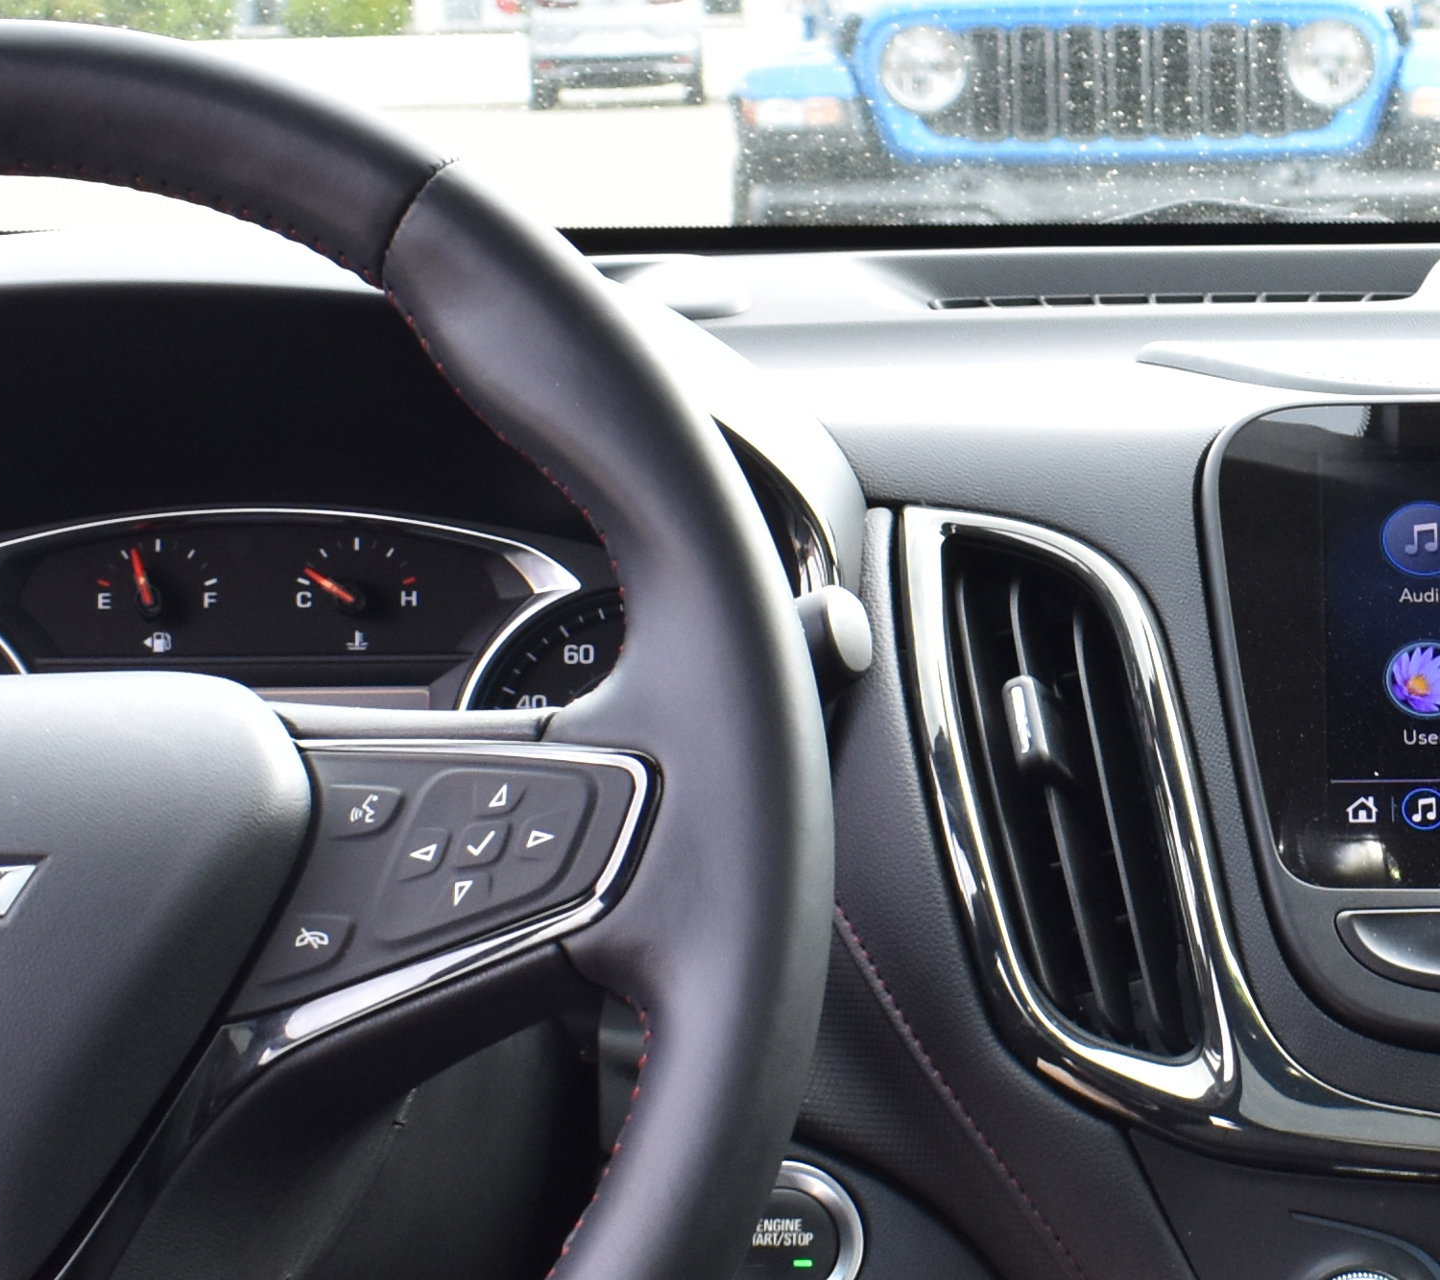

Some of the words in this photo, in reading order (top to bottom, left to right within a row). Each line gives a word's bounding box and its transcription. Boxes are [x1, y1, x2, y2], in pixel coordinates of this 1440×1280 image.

[96, 592, 112, 610] E
[202, 591, 218, 609] F
[296, 591, 313, 609] C
[400, 590, 418, 608] H
[563, 644, 595, 665] 60
[515, 694, 548, 709] 40
